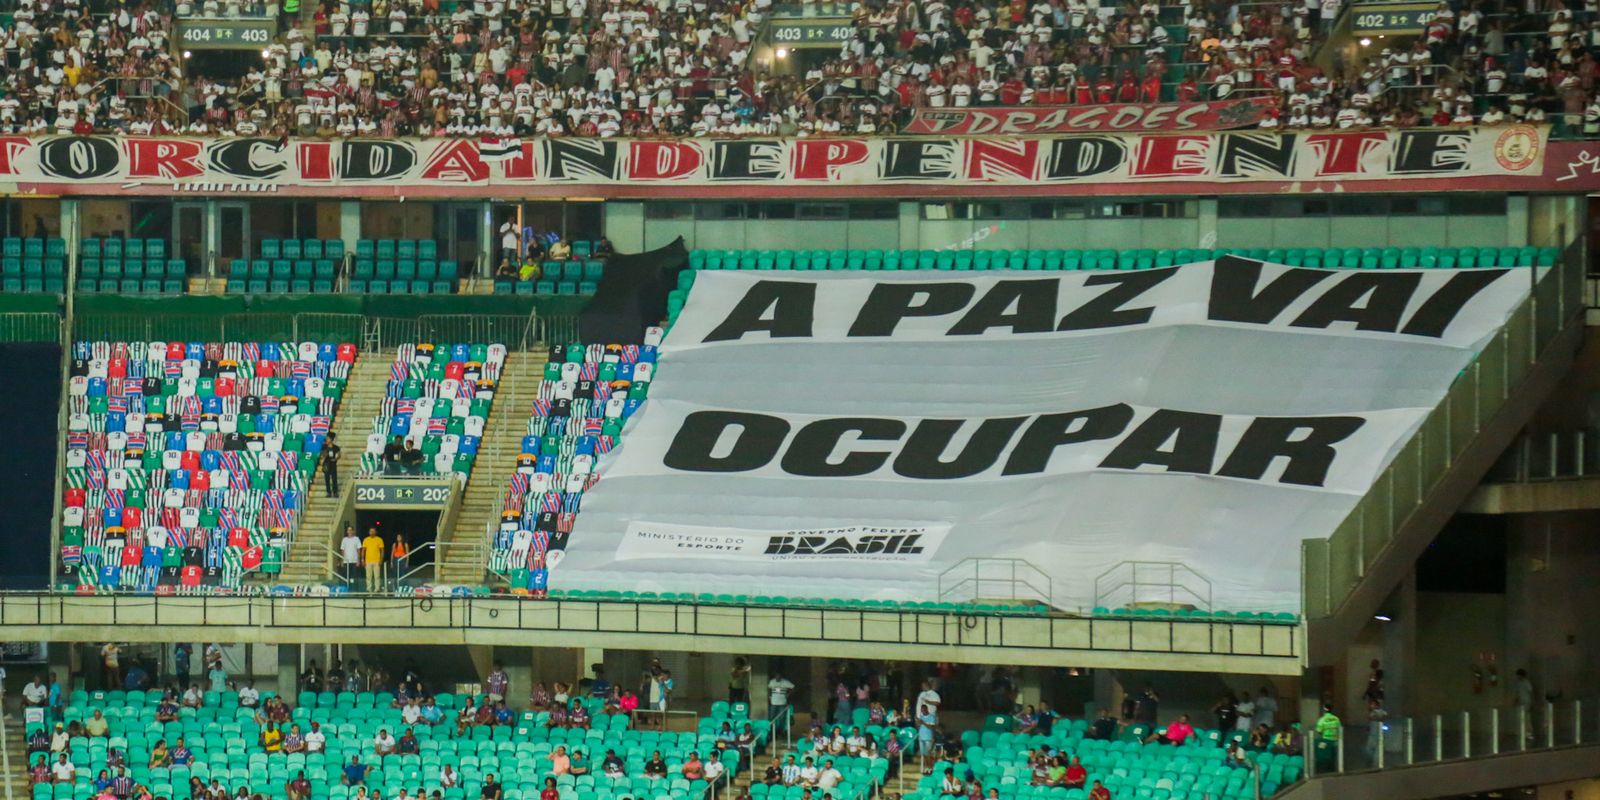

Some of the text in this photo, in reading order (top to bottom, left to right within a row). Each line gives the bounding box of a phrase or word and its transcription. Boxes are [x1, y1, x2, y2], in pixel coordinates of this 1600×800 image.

[1356, 15, 1384, 27] 402
[184, 29, 268, 41] 404 403
[776, 28, 802, 40] 403
[500, 128, 1478, 183] INDEPENDENTE
[701, 255, 1511, 342] A PAZ VAI
[663, 403, 1366, 487] OCUPAR
[357, 488, 385, 500] 204
[677, 543, 742, 551] ESPORTE
[764, 534, 924, 554] BRASIL
